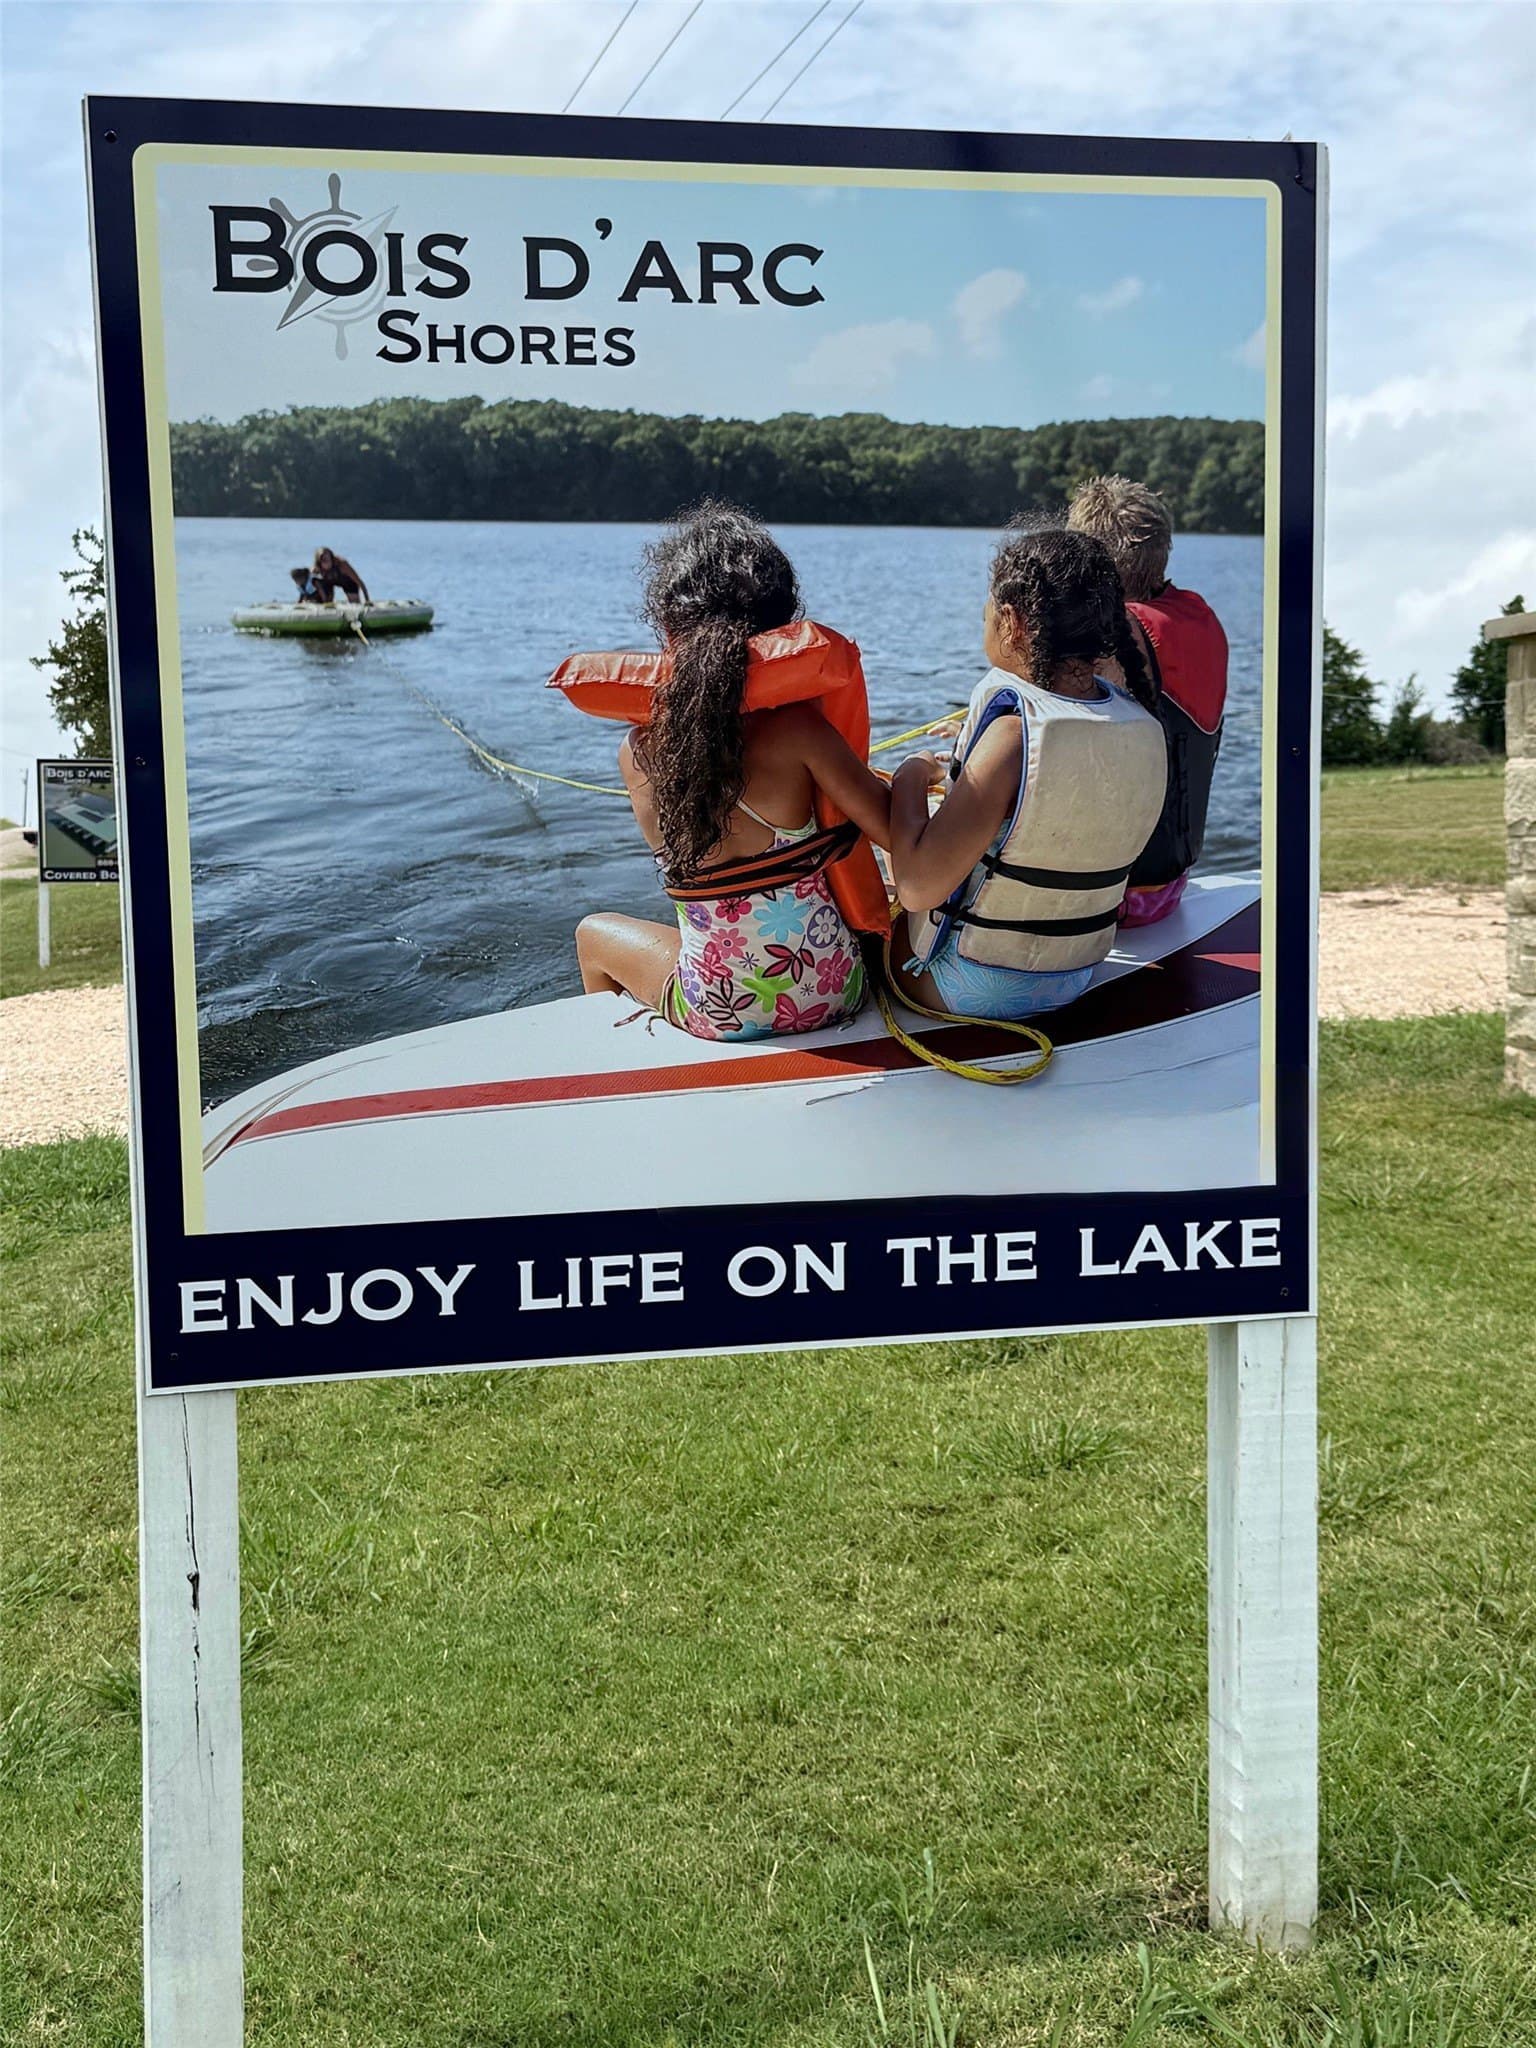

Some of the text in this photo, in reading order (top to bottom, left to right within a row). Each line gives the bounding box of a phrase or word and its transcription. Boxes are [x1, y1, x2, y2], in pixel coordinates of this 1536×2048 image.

[208, 204, 472, 299] BOIS
[375, 309, 637, 367] SHORES
[100, 870, 119, 880] BO
[178, 1217, 1283, 1334] ENJOY LIFE ON THE LAKE
